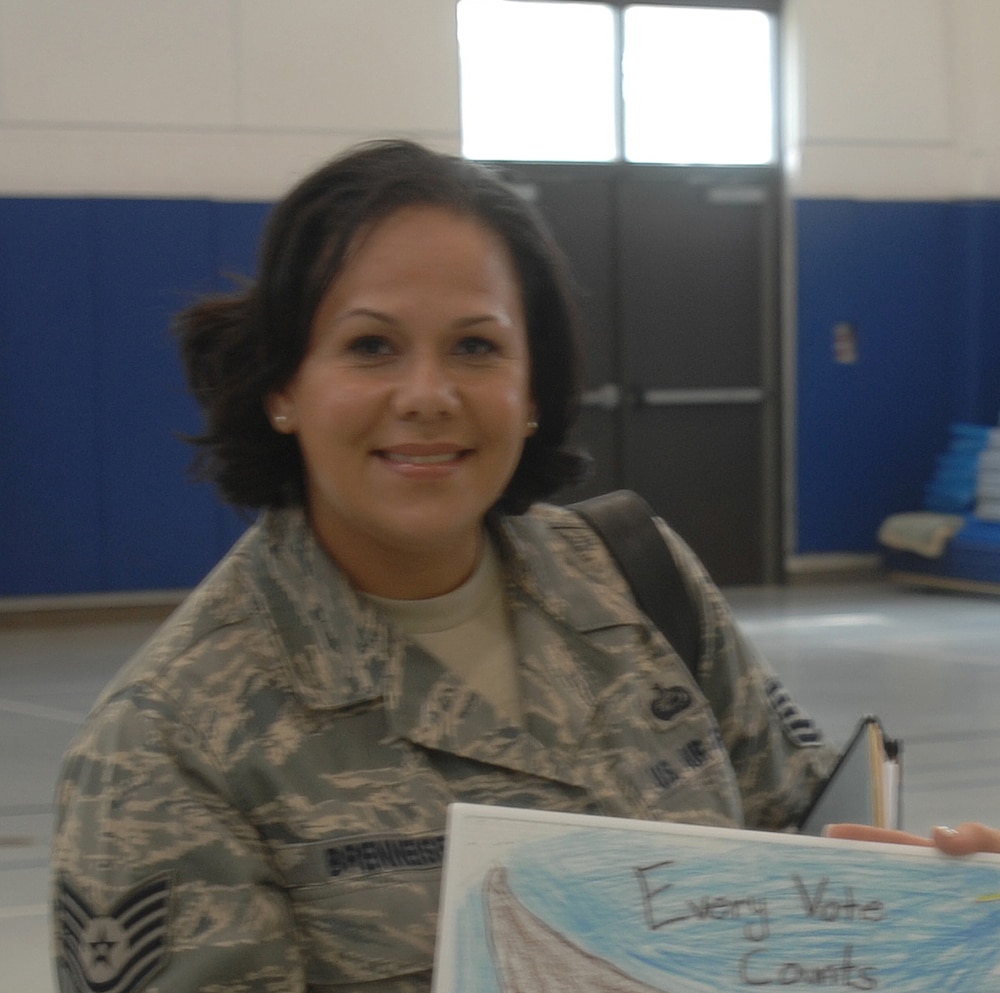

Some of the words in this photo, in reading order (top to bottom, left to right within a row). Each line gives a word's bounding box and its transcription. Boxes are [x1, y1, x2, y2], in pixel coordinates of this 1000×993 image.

[633, 859, 771, 942] Every
[791, 874, 887, 923] Vote
[737, 944, 878, 991] Counts
